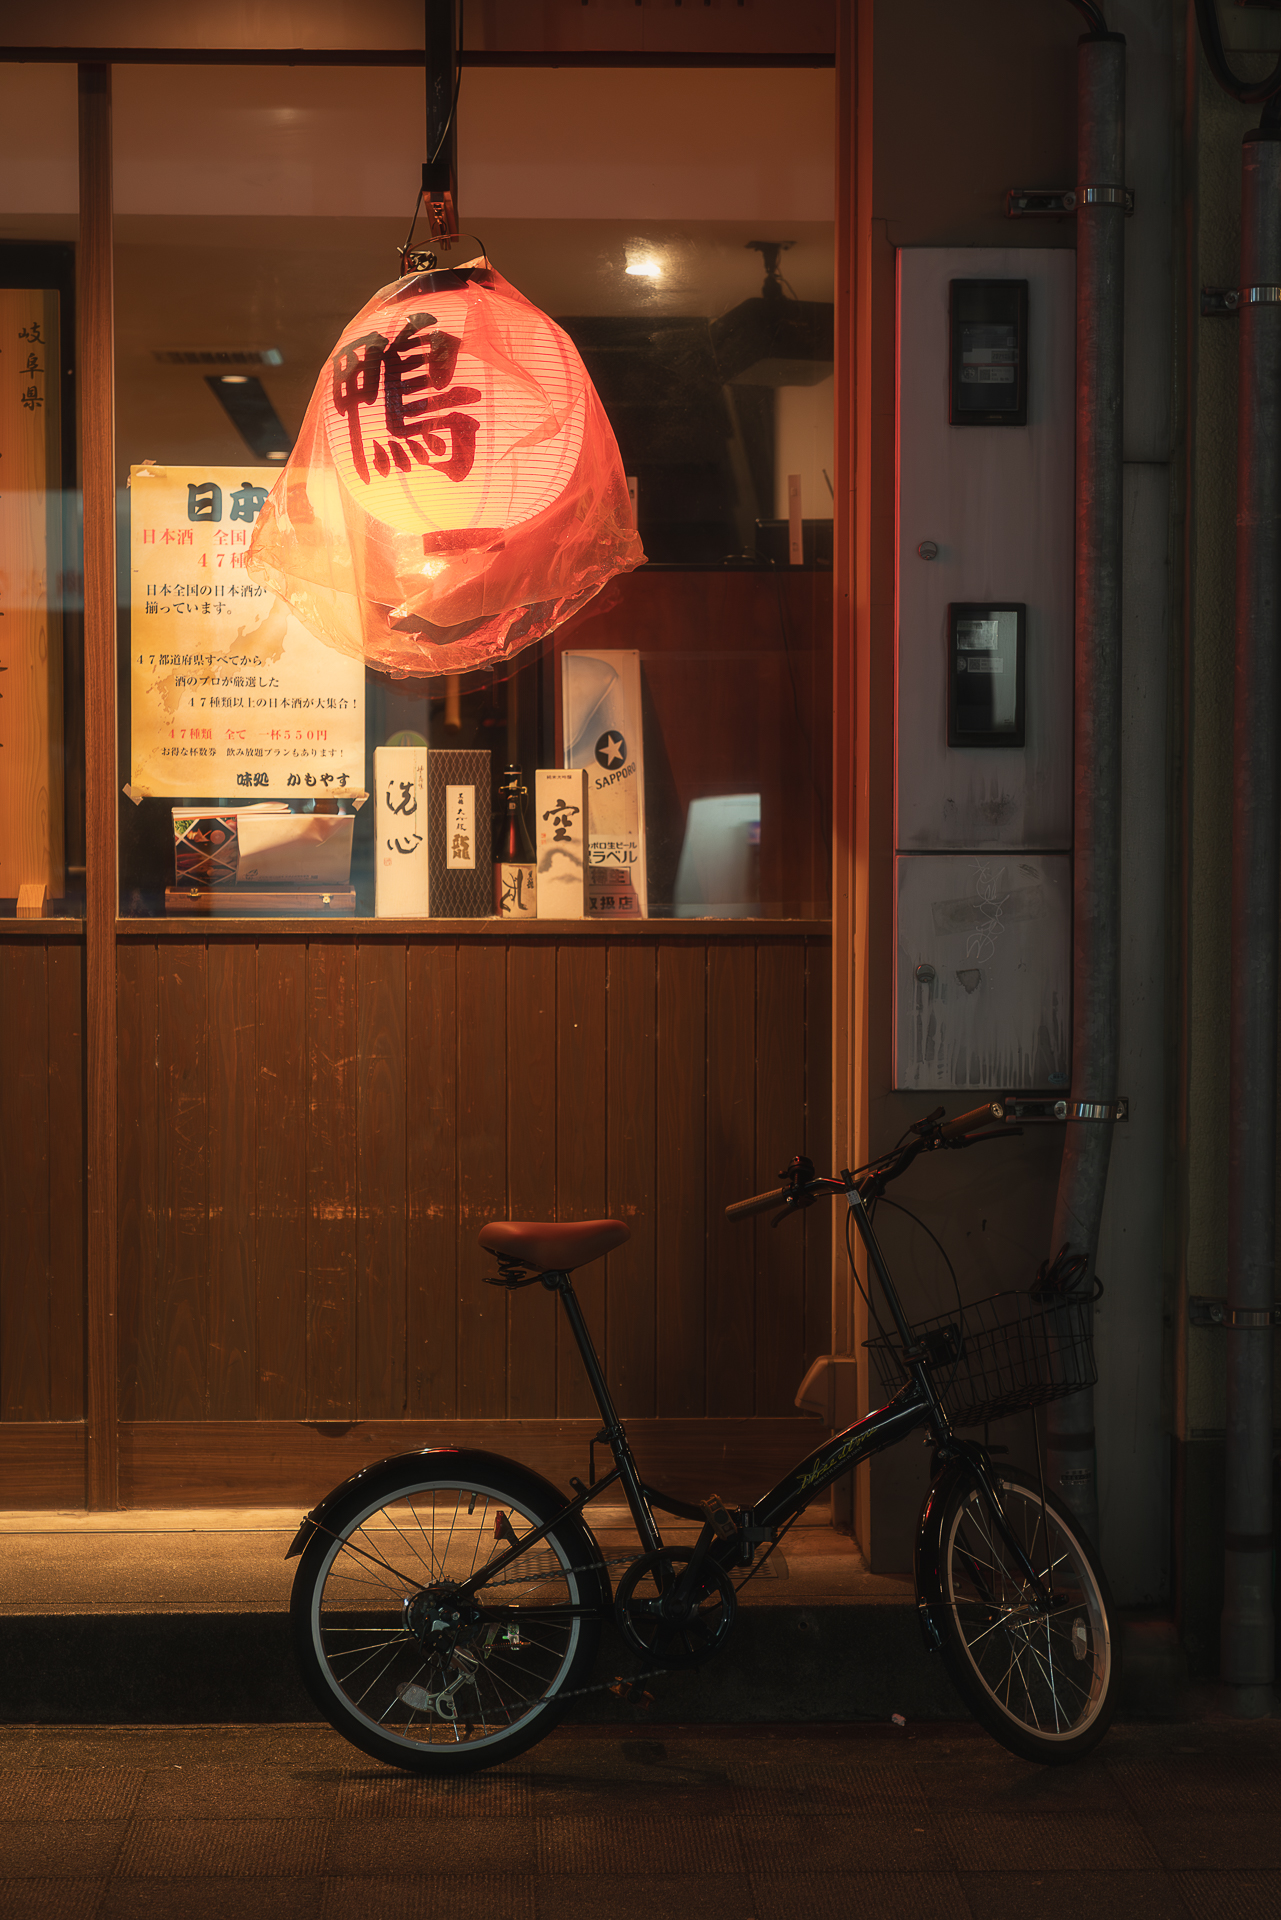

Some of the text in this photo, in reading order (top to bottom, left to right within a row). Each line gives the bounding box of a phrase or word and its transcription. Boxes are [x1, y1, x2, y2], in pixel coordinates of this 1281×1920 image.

[18, 322, 46, 411] 岐阜県
[332, 312, 482, 486] 鴨
[143, 529, 246, 546] 日本酒 全国
[146, 584, 267, 598] 日本全国の日本酒が
[145, 601, 232, 615] 揃っています。
[175, 676, 279, 688] 酒のプロが厳選した
[224, 729, 247, 740] 全て
[236, 772, 350, 787] 味処 かもやす
[595, 762, 636, 790] SAPPORO
[543, 799, 580, 842] 空
